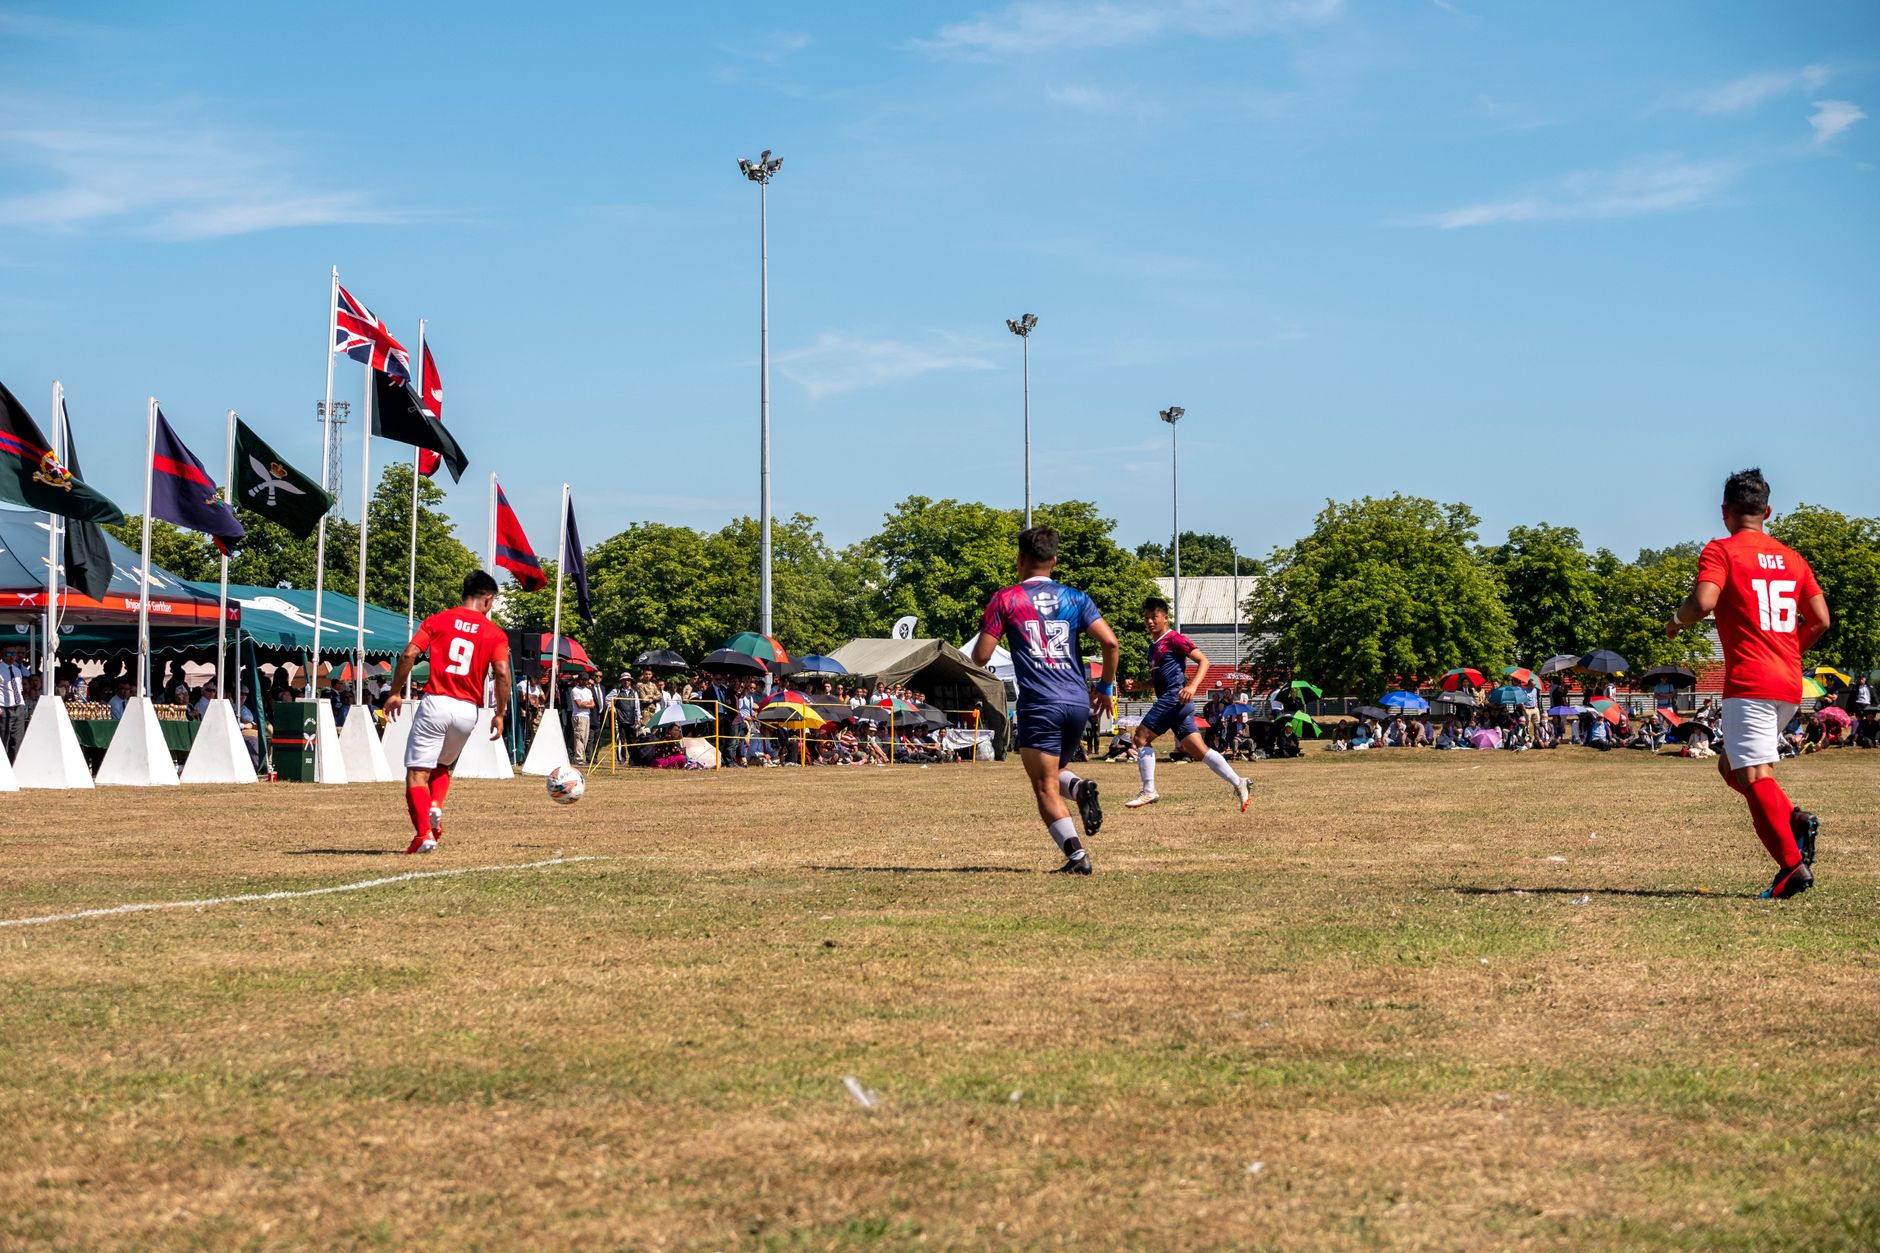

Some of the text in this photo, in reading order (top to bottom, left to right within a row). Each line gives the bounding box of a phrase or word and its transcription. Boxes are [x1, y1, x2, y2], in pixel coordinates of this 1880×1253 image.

[1751, 578, 1797, 633] 16
[444, 637, 475, 677] 9
[1024, 620, 1071, 658] 12
